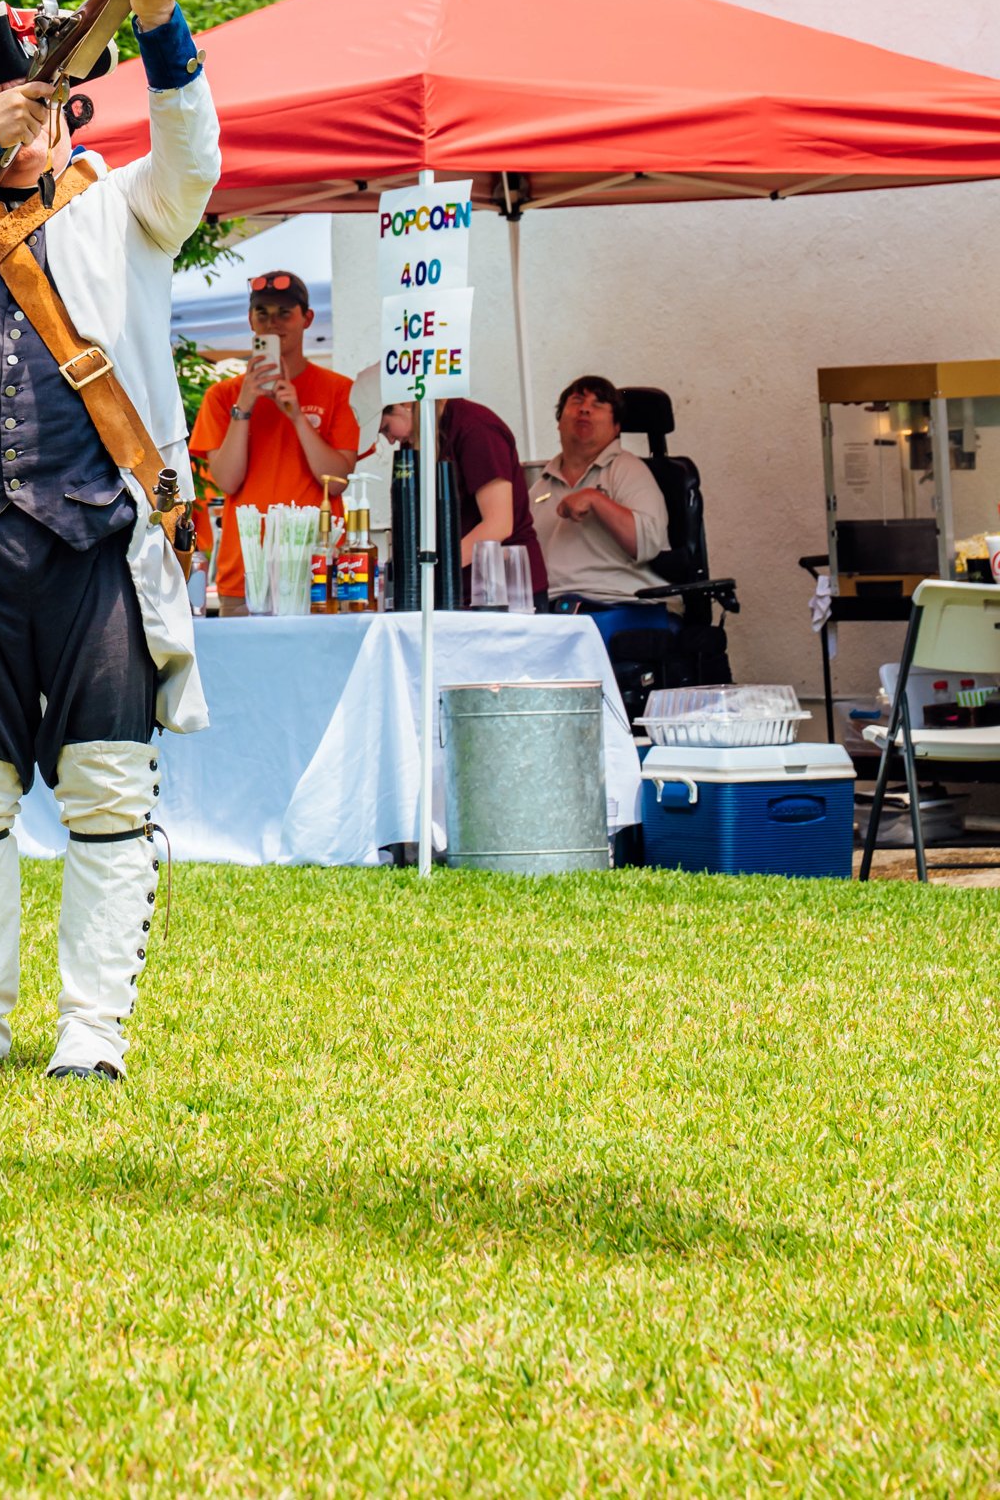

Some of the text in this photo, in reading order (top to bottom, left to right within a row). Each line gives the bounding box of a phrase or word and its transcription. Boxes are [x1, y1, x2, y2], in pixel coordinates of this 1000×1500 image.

[380, 201, 472, 238] POPCORN
[401, 259, 441, 288] 4.00
[386, 348, 461, 375] COFFEE
